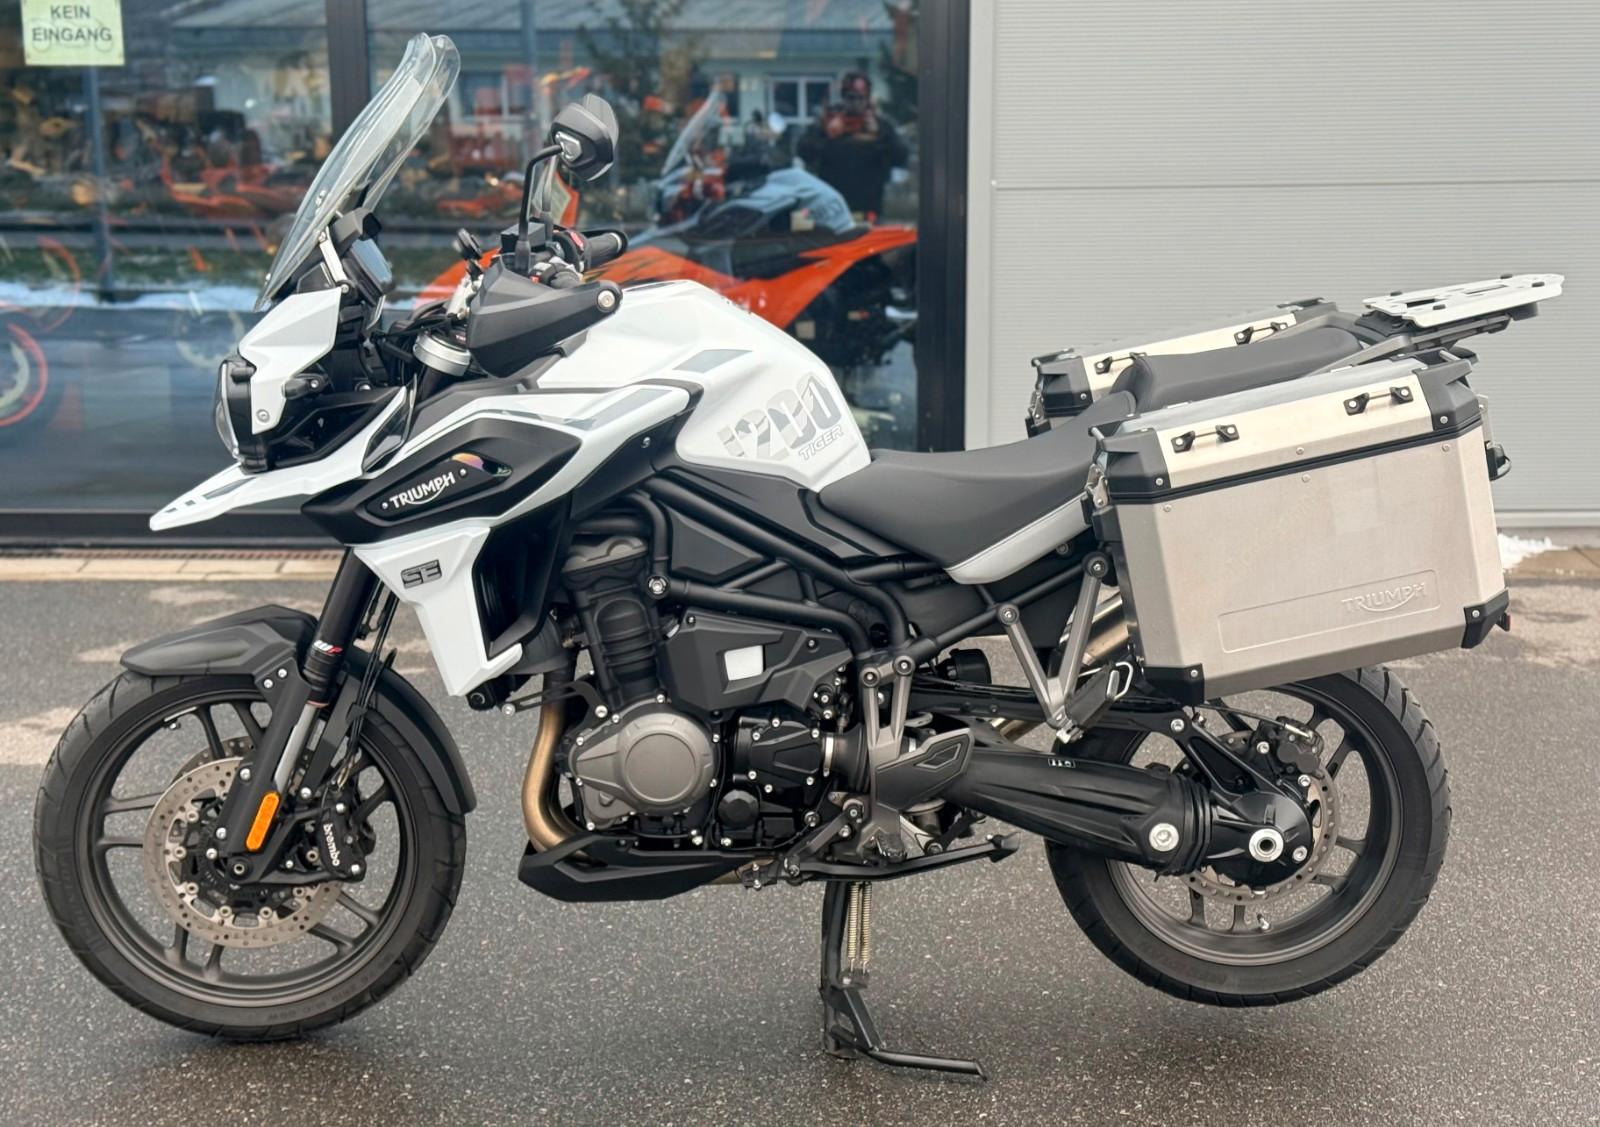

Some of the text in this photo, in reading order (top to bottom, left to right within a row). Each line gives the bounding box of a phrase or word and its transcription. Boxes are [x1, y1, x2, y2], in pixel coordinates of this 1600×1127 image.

[50, 5, 90, 19] KEIN
[32, 27, 112, 41] EINGANG
[799, 424, 845, 461] TIGER
[389, 471, 456, 509] TRIUMPH
[400, 559, 442, 589] SE
[1341, 582, 1427, 612] TRIUMPH
[323, 823, 340, 867] brembo
